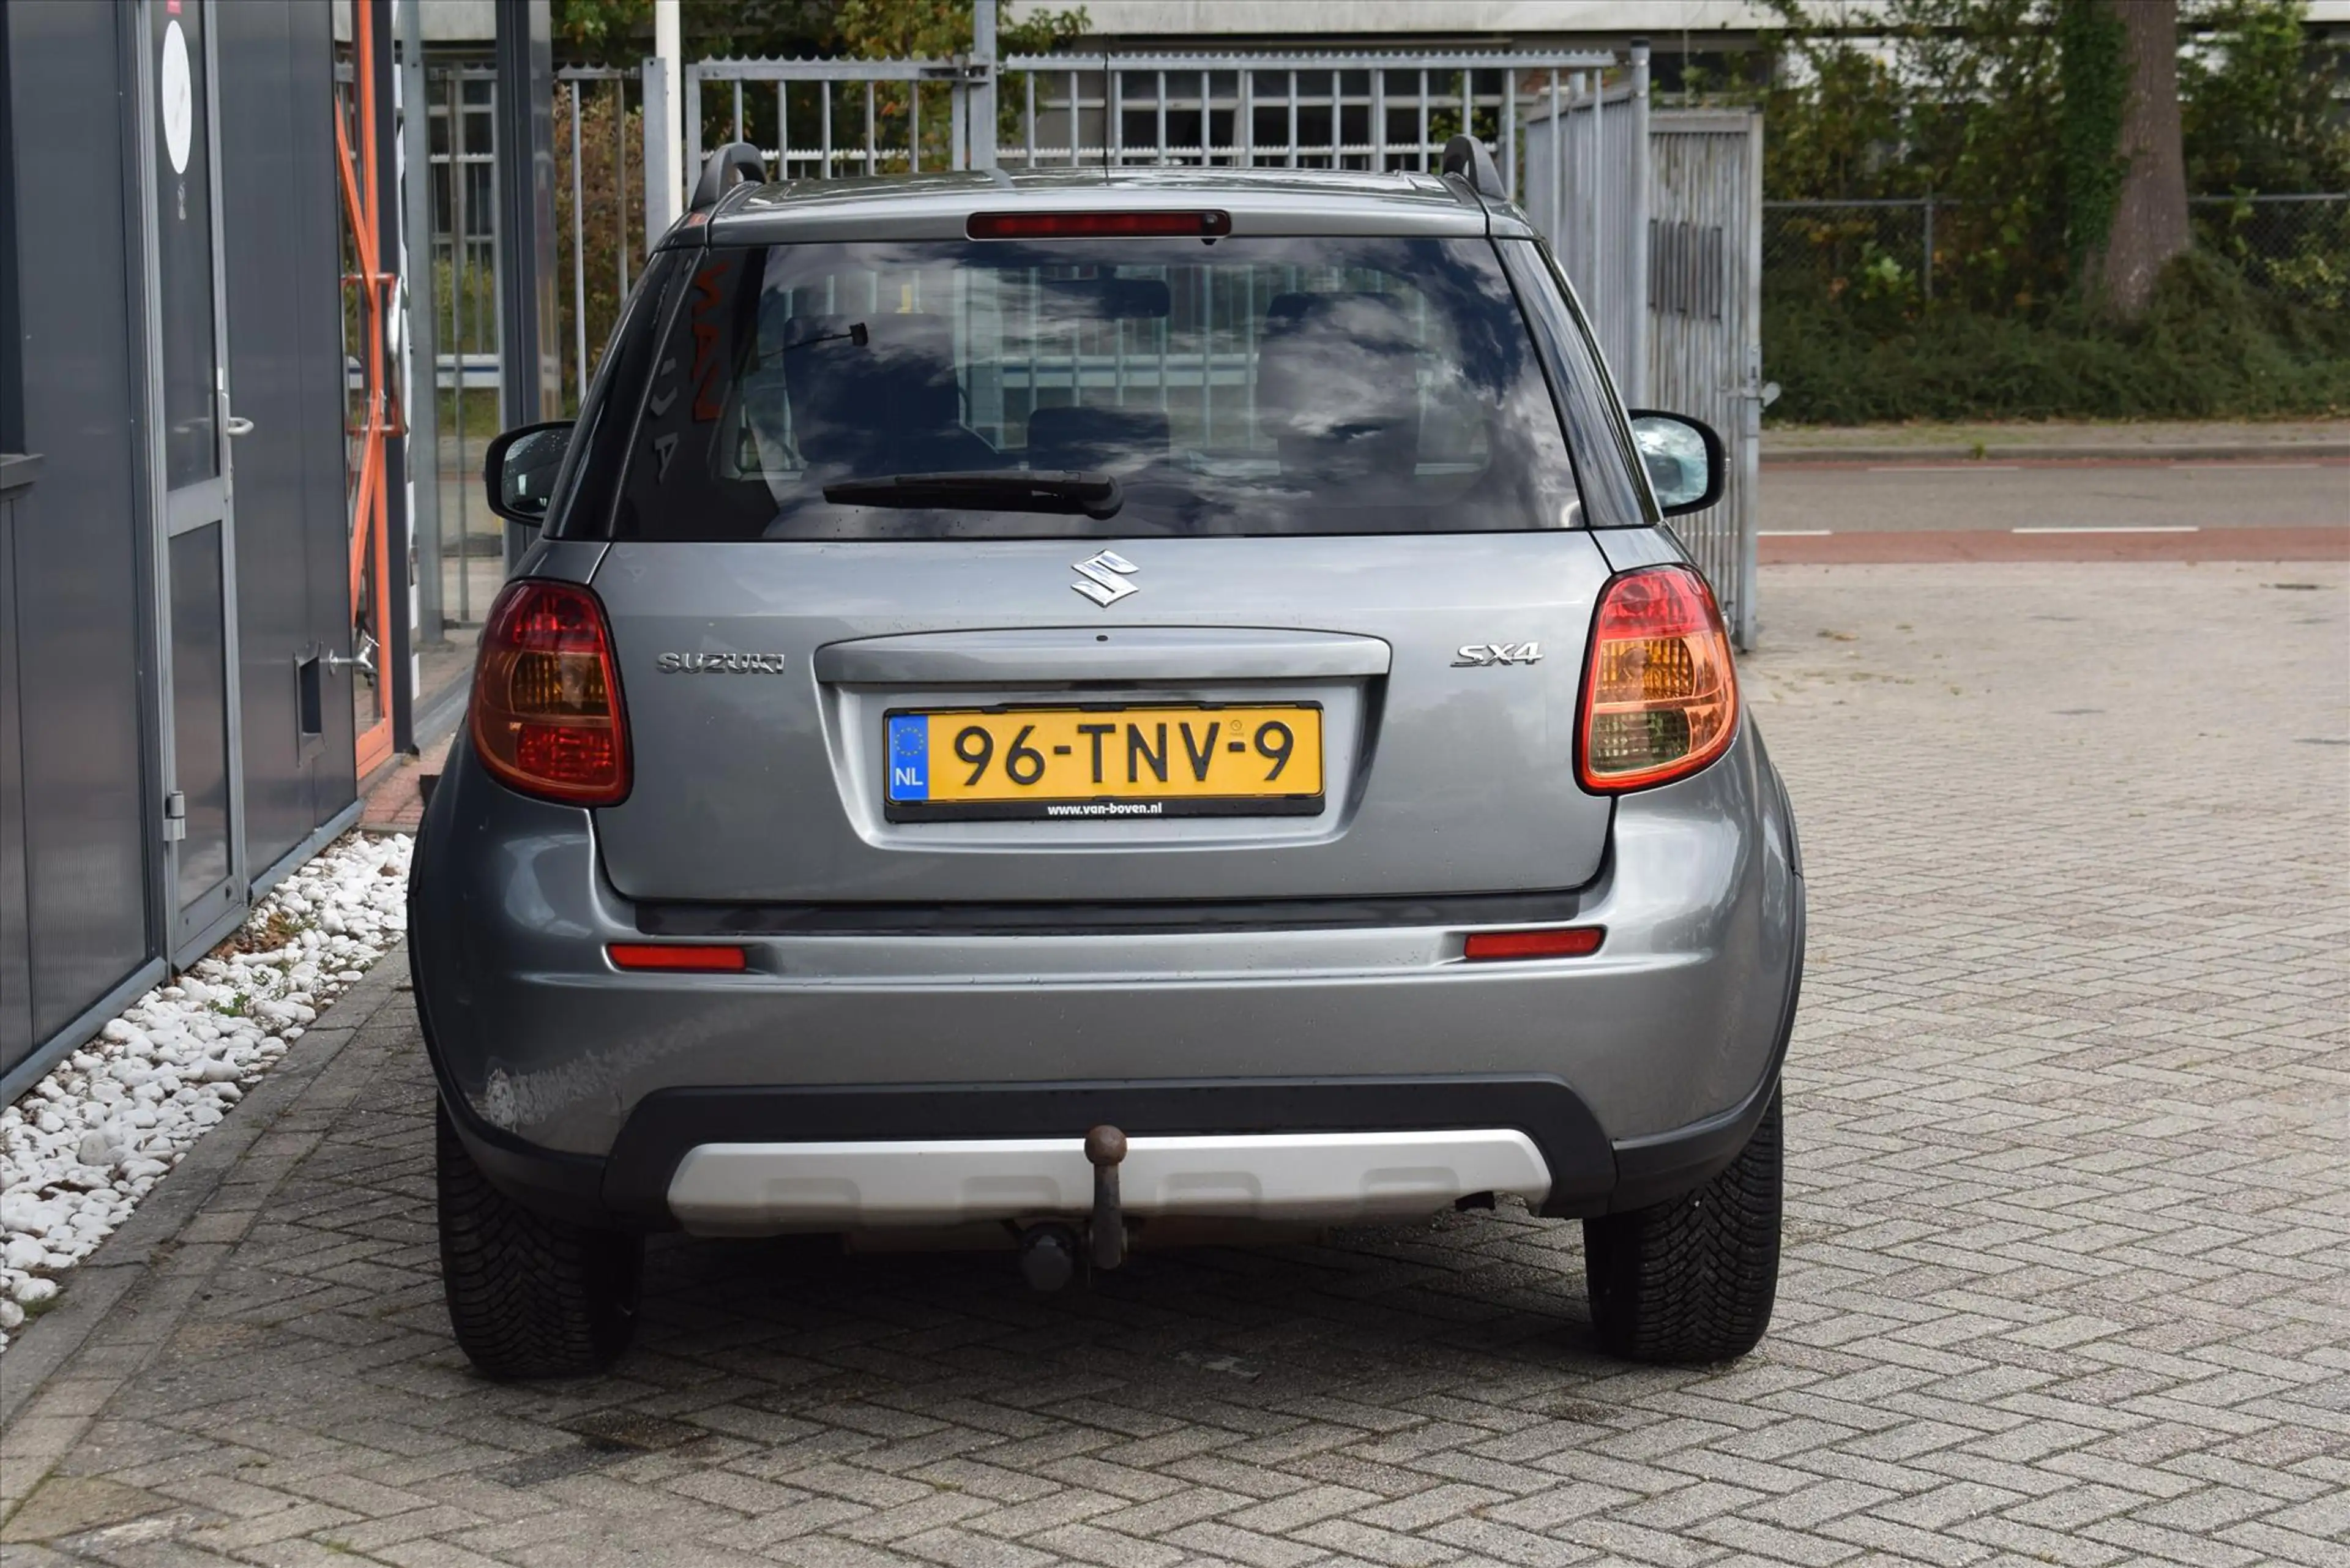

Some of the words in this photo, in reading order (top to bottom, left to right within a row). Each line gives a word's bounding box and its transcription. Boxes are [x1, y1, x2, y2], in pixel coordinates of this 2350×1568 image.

[656, 652, 785, 674] SUZUKI
[1450, 641, 1544, 667] SX4
[954, 720, 1294, 786] 96-TNV-9
[895, 767, 923, 786] NL
[1047, 802, 1163, 815] www.van-boven.nl
